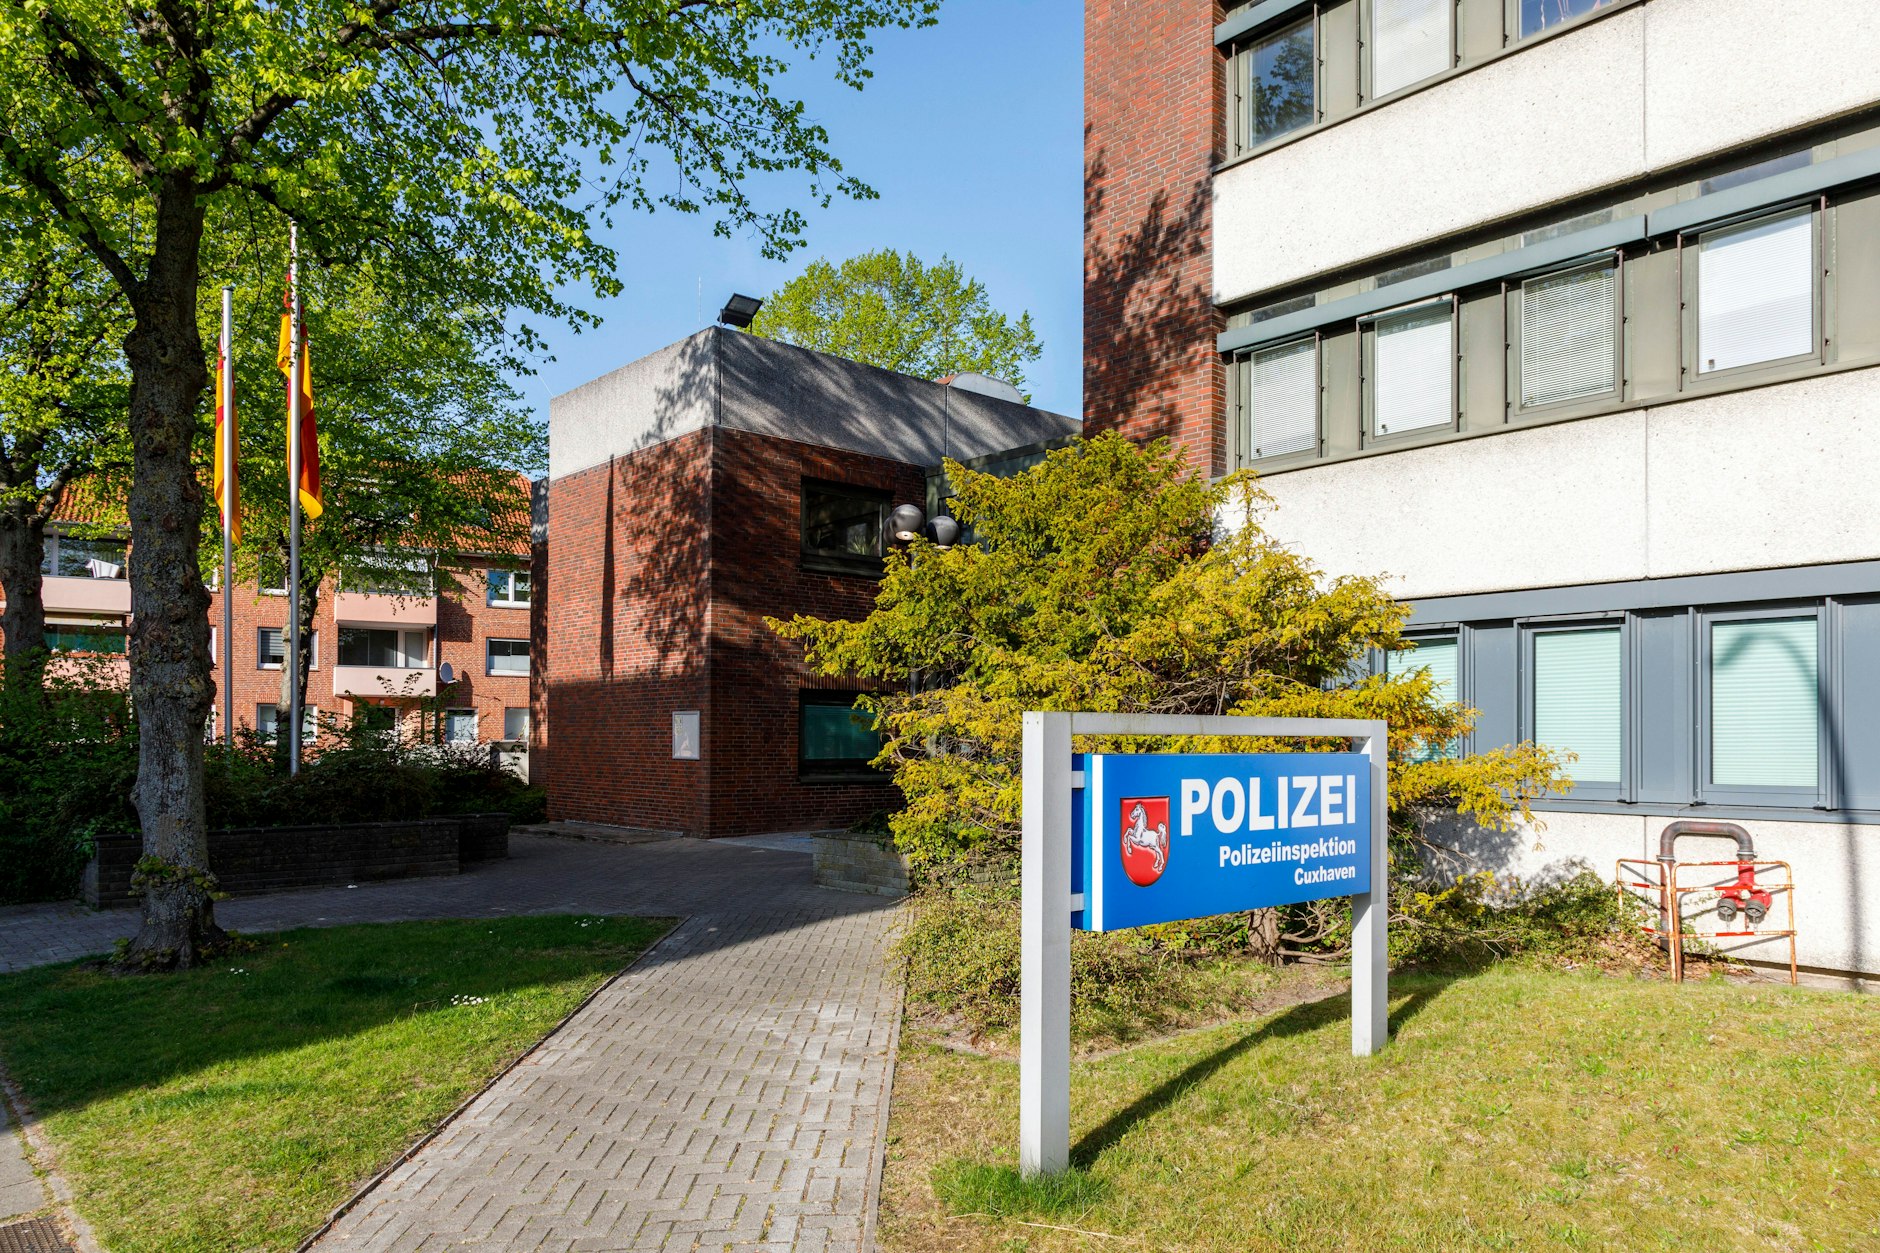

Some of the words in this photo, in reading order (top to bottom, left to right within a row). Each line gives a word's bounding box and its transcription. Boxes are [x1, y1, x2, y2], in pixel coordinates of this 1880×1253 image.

[1181, 775, 1355, 836] POLIZEI
[1219, 837, 1355, 867] Polizeiinspektion
[1294, 865, 1355, 885] Cuxhaven
